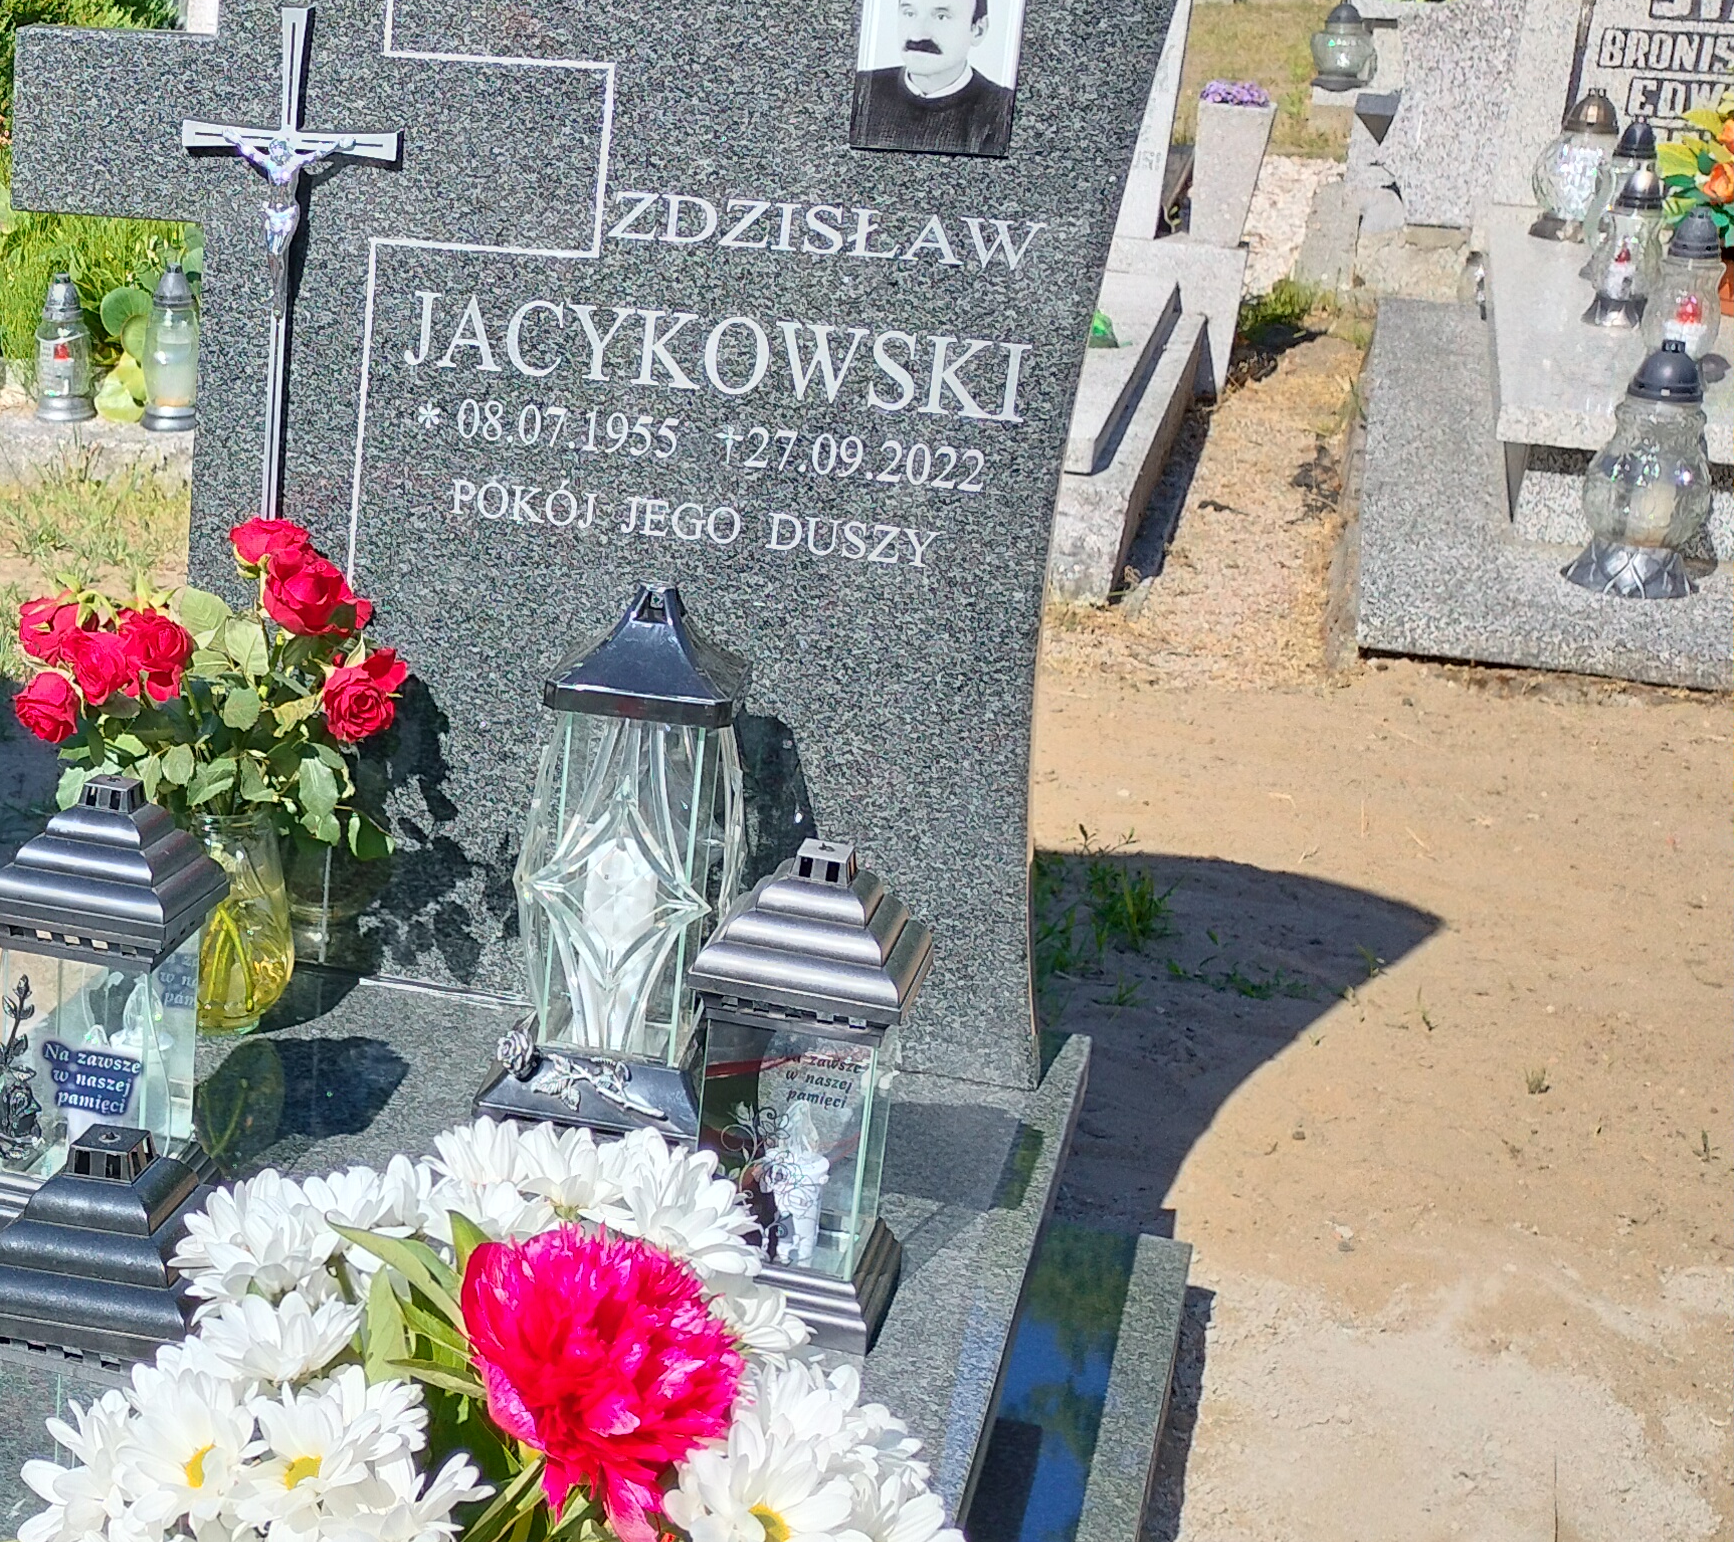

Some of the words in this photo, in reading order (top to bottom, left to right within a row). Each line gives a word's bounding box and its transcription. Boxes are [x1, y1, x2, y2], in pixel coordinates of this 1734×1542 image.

[607, 188, 1048, 272] ZDZISŁAW
[403, 289, 1035, 424] JACYKOWSKI
[447, 477, 598, 529] POKÓJ
[620, 496, 742, 545] JEGO
[765, 513, 940, 570] DUSZY
[44, 1043, 70, 1062] Na
[77, 1052, 141, 1074] zawsze
[52, 1069, 69, 1083] w
[75, 1073, 132, 1098] naszej
[785, 1069, 799, 1081] w
[805, 1073, 853, 1094] naszej
[57, 1091, 126, 1114] pamięci
[787, 1088, 848, 1110] pamięci
